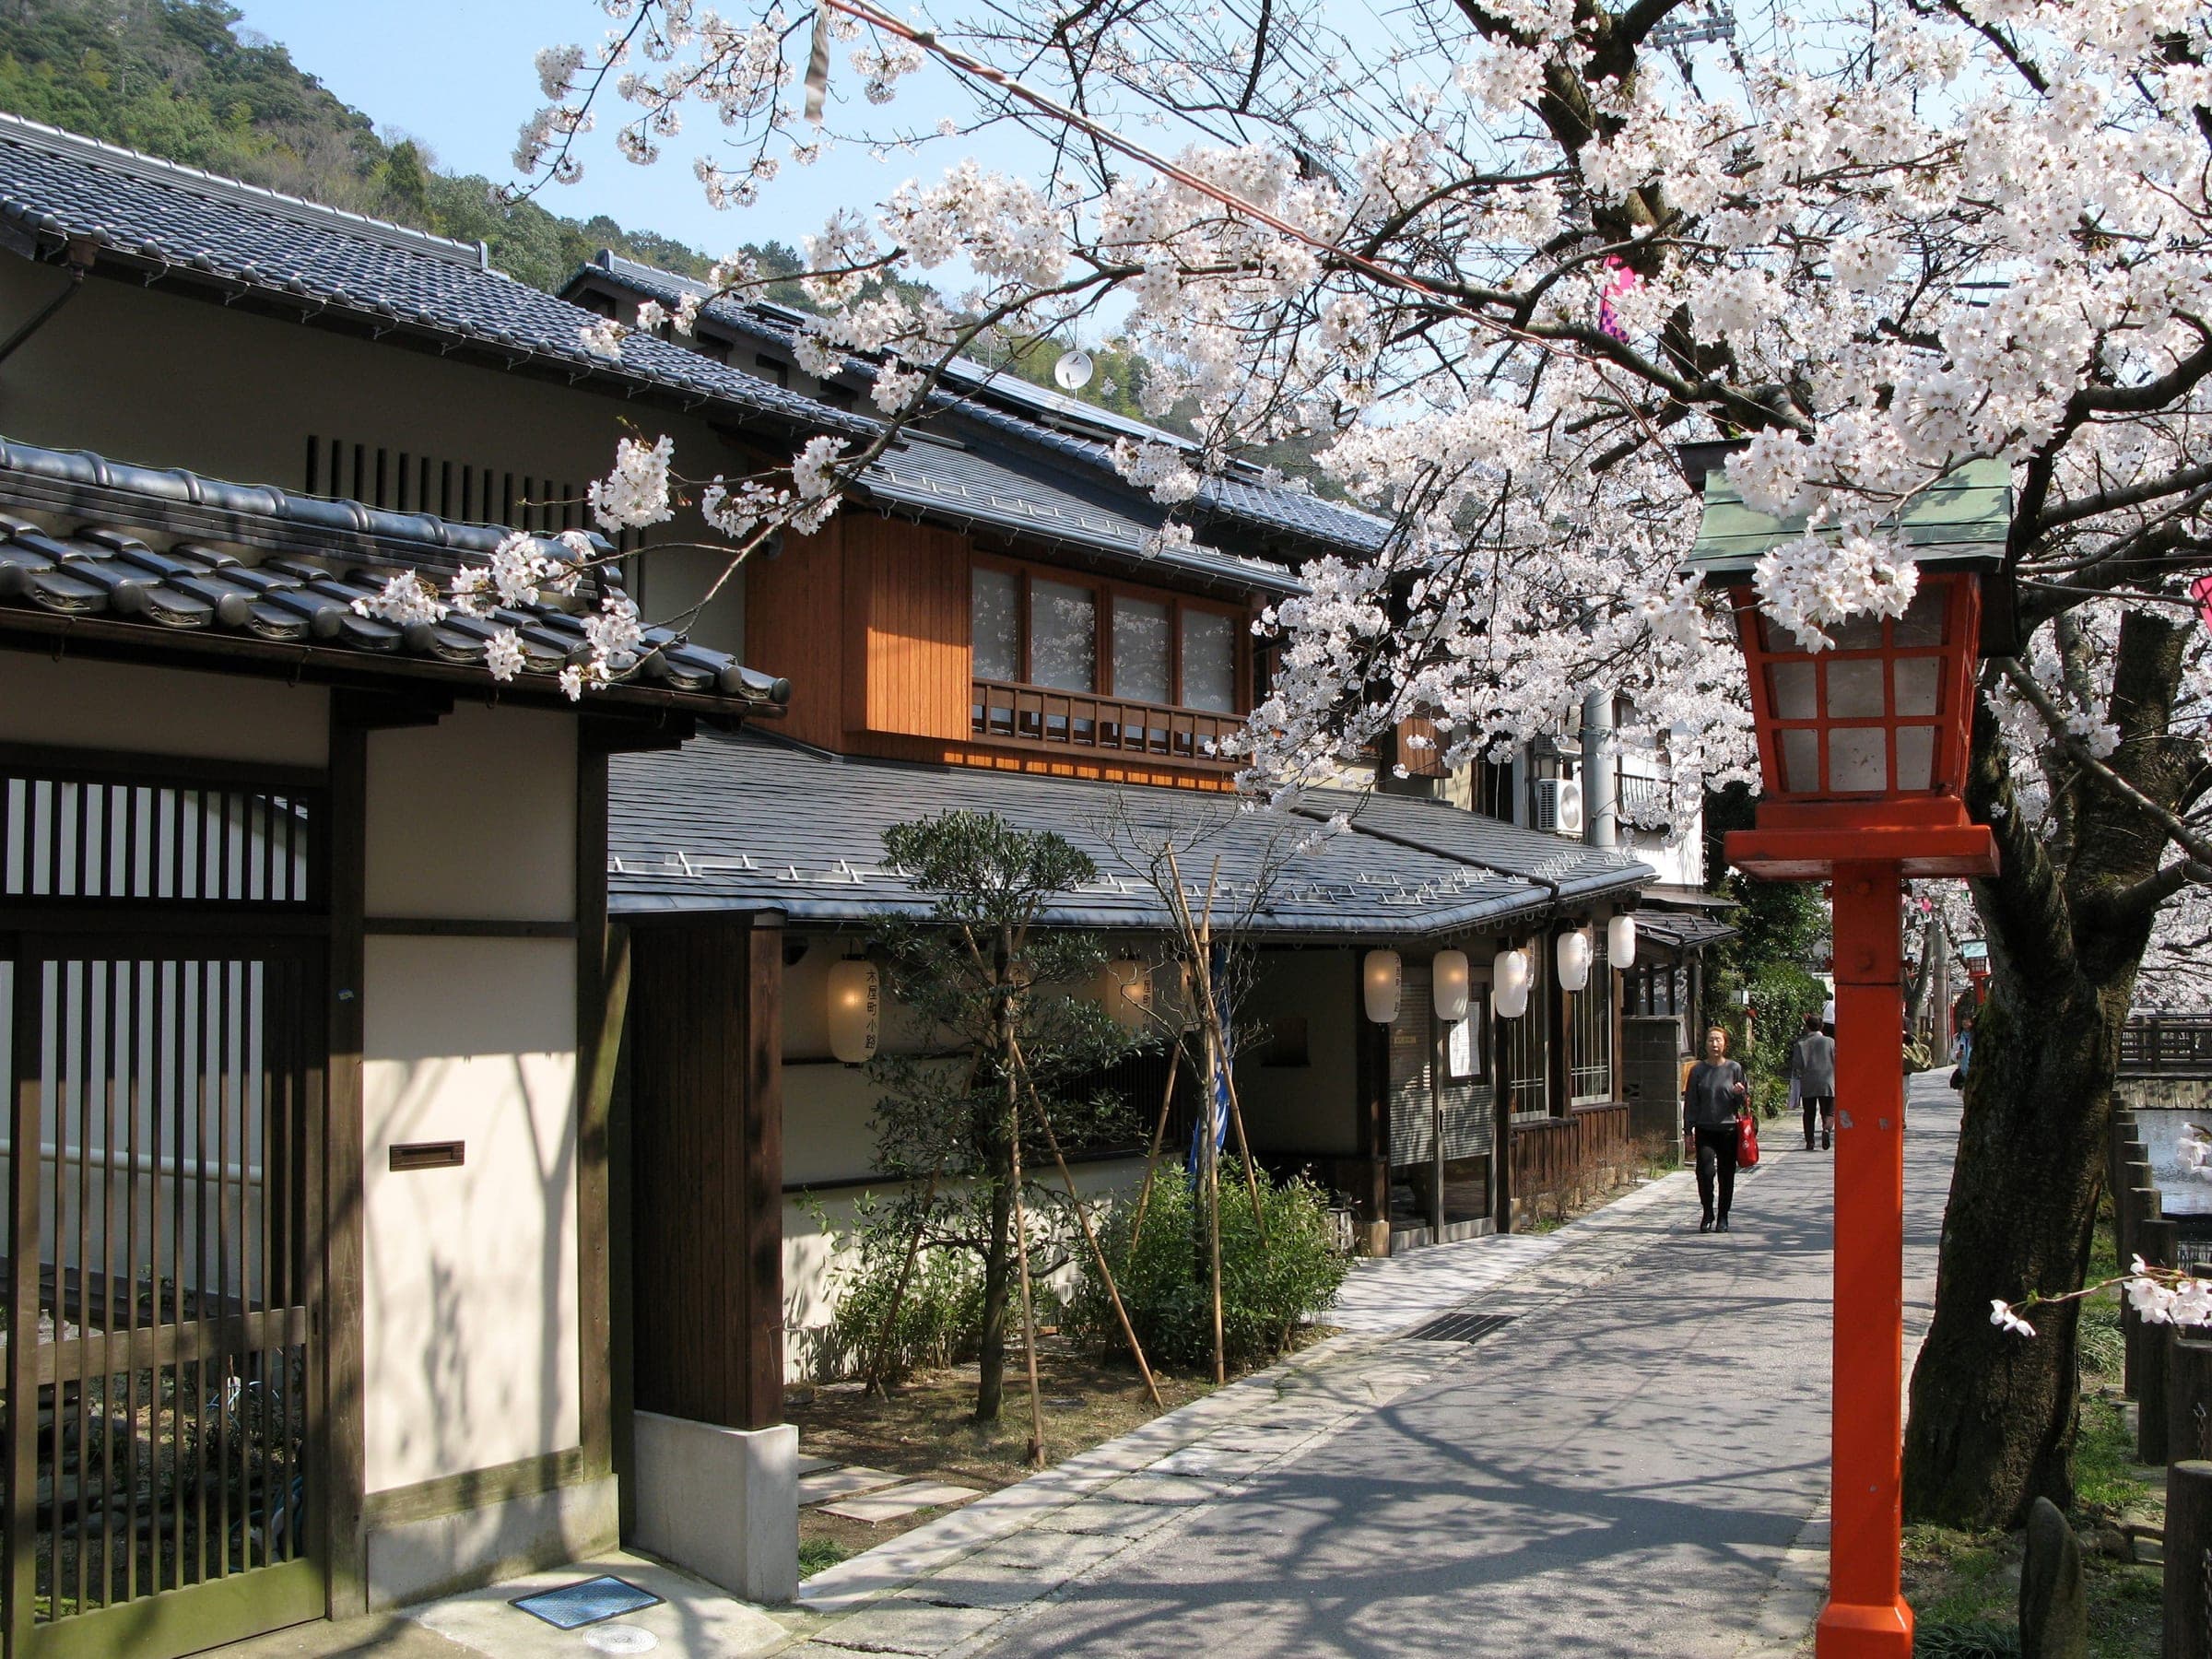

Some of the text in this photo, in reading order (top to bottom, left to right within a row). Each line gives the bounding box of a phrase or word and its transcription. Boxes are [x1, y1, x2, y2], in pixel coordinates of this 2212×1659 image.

[865, 970, 877, 1049] 木屋町小路
